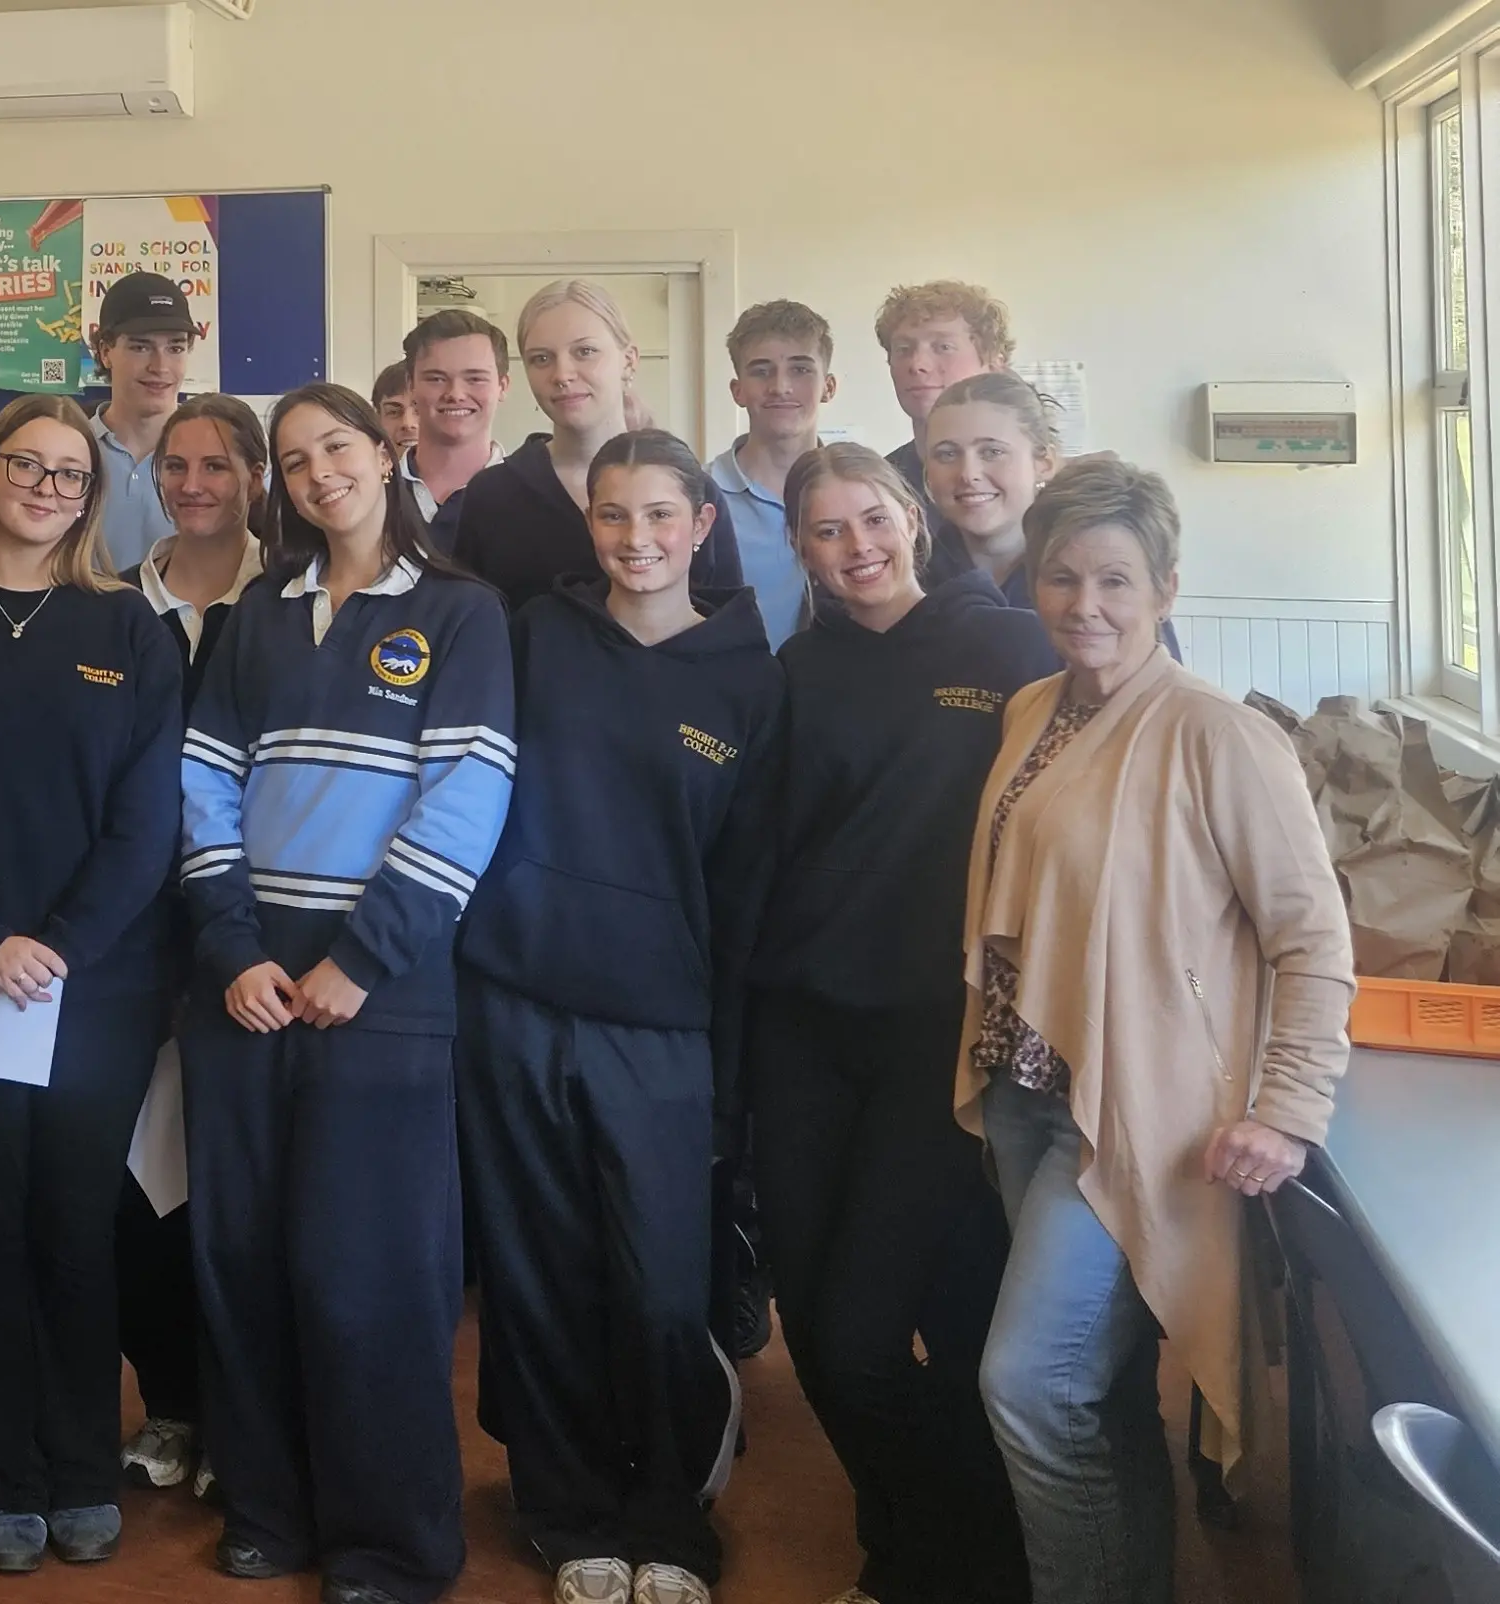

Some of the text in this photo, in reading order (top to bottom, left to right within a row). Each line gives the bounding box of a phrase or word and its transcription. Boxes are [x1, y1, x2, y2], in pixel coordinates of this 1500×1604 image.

[90, 240, 211, 257] OUR SCHOOL
[22, 254, 61, 273] talk
[89, 260, 211, 275] STANDS UP FOR
[932, 686, 978, 698] BRIGHT
[939, 697, 995, 713] COLLEGE
[678, 723, 738, 758] BRIGHT P-12
[683, 737, 726, 765] COLLEGE
